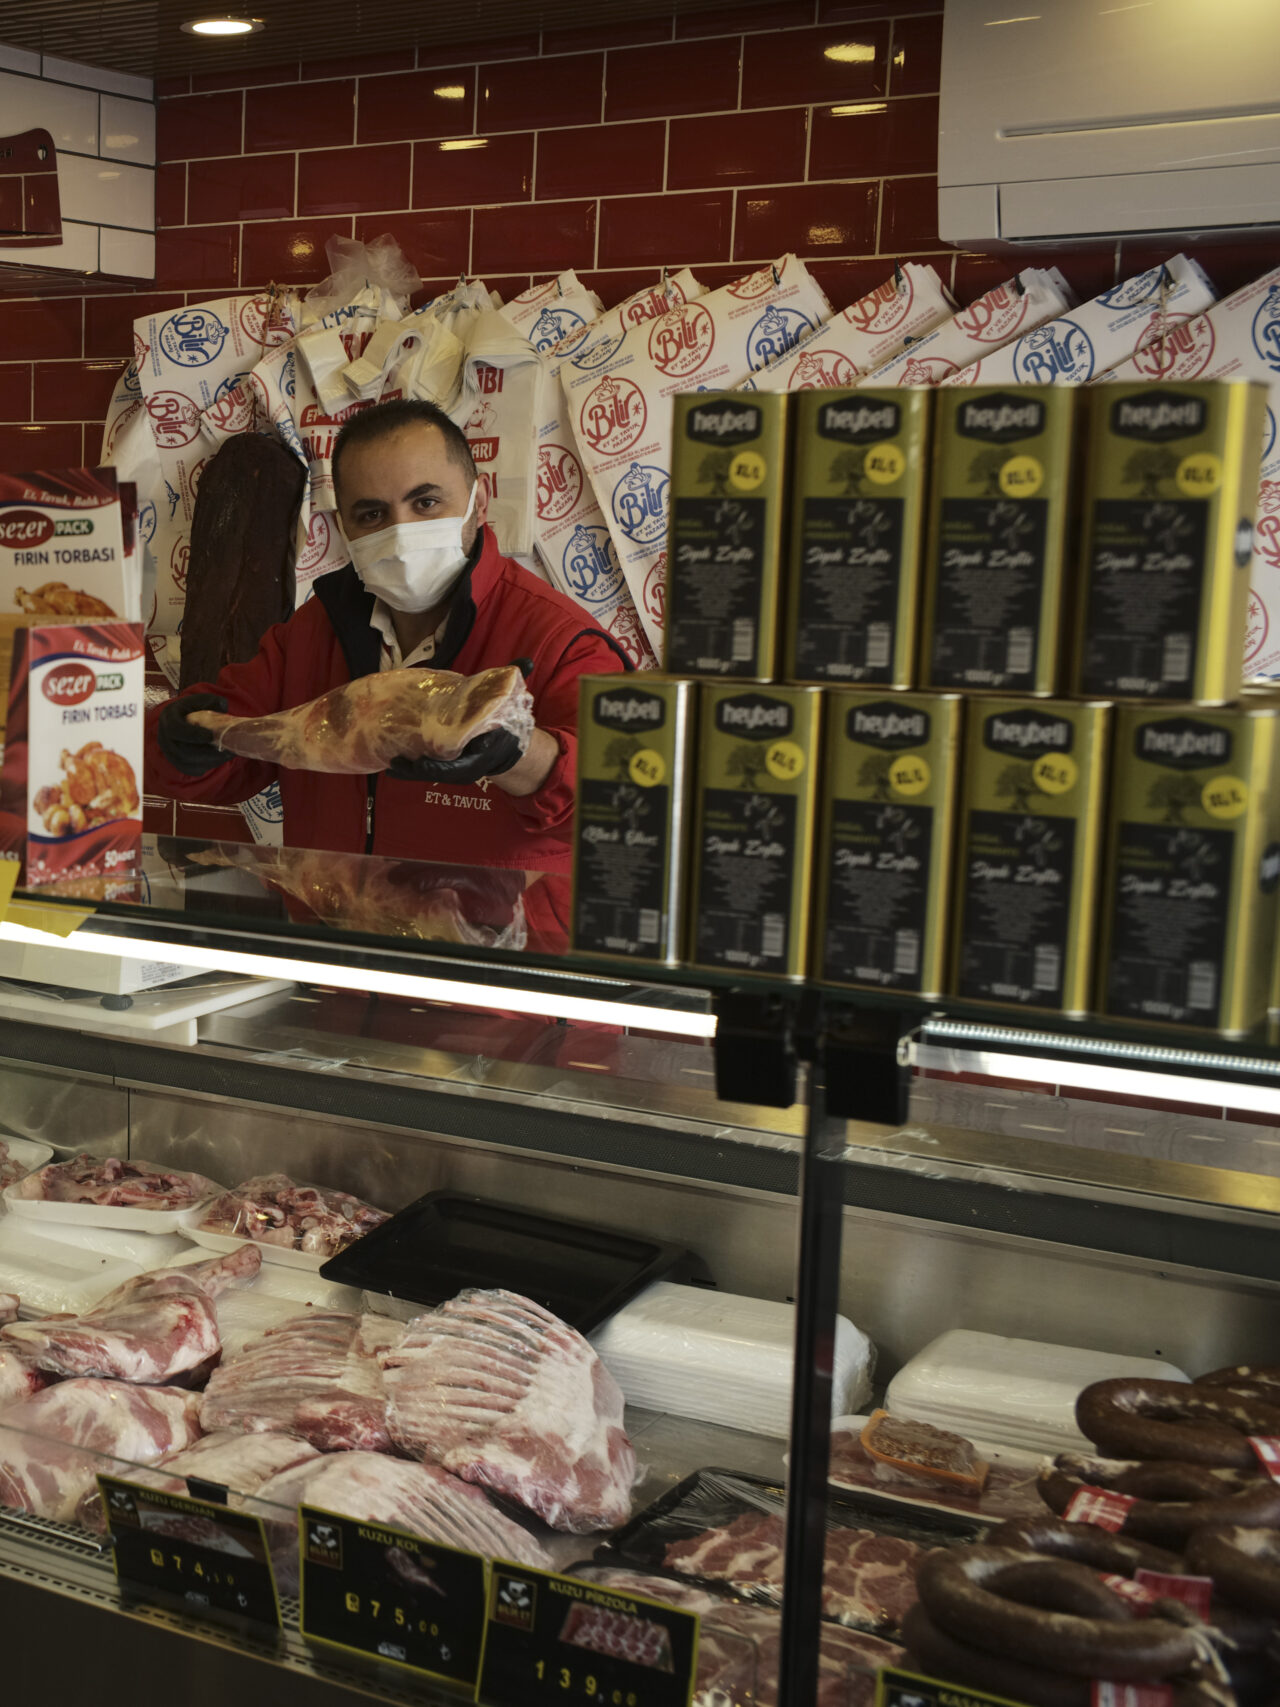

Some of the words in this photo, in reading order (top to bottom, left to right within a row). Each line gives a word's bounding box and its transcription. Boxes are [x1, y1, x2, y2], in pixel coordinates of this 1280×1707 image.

[656, 311, 706, 363] Bilir
[587, 390, 638, 443] Bilir
[612, 433, 634, 449] PAZARI
[620, 478, 670, 534] Bilir
[56, 521, 91, 535] PACK
[14, 550, 49, 566] FIRIN
[55, 547, 116, 564] TORBASI
[571, 538, 613, 590] Bilir
[47, 674, 92, 696] sezer
[95, 674, 122, 691] PACK
[62, 706, 91, 725] FIRIN
[94, 703, 138, 721] TORBASI
[424, 791, 442, 804] ET
[442, 793, 451, 806] &
[452, 796, 493, 811] TAVUK
[138, 1490, 169, 1507] KUZU
[170, 1498, 216, 1520] GERDAN
[357, 1526, 394, 1546] KUZU
[395, 1537, 422, 1554] KOL
[548, 1580, 584, 1599] KUZU
[584, 1589, 639, 1615] PİRZOLA
